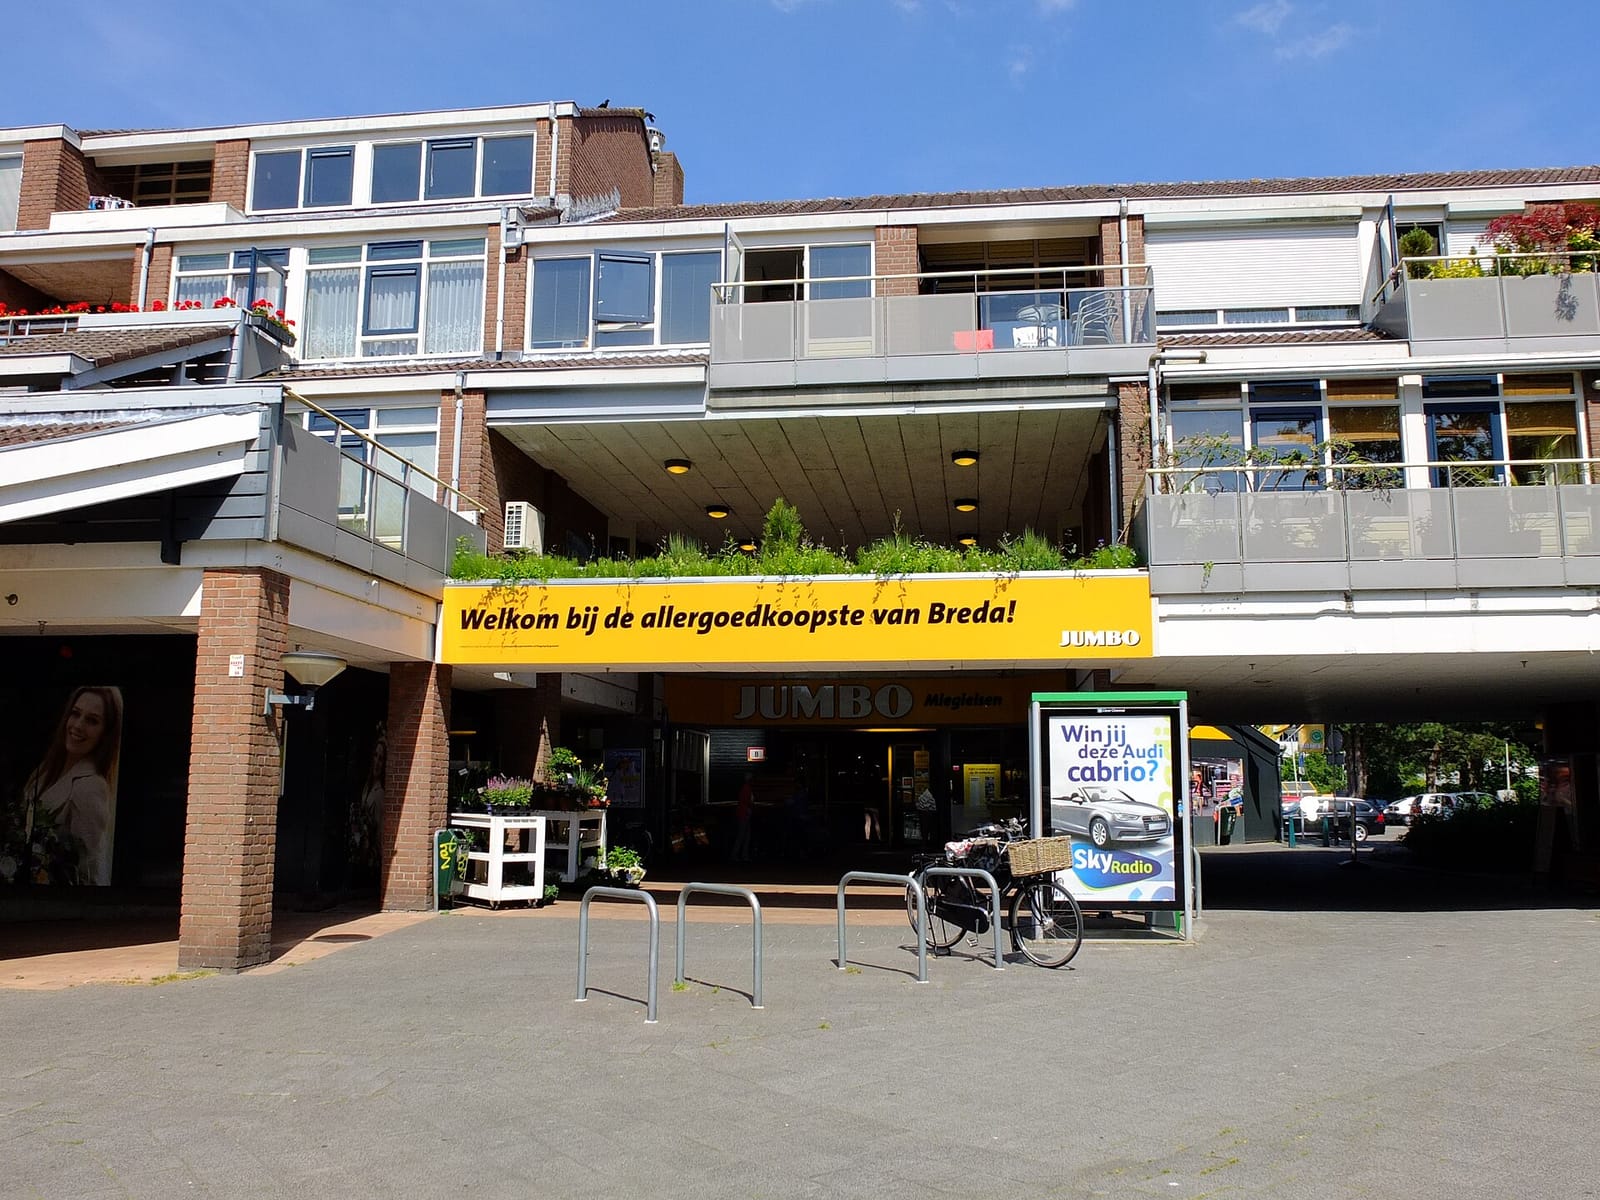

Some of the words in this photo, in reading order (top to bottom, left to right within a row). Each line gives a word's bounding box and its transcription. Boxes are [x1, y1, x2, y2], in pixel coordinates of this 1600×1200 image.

[460, 607, 560, 630] Welkom
[566, 606, 600, 636] bij
[604, 606, 634, 629] de
[640, 604, 865, 635] allergoedkoopste
[872, 607, 921, 625] van
[927, 600, 1017, 625] Breda!
[1059, 629, 1141, 648] JUMBO
[733, 683, 914, 720] JUMBO
[1061, 724, 1103, 743] Win
[1103, 724, 1126, 747] jij
[1078, 744, 1119, 759] deze
[1122, 743, 1163, 759] Audi
[1067, 759, 1159, 783] cabrio?
[1073, 848, 1113, 874] Sky
[1111, 860, 1154, 874] Radio
